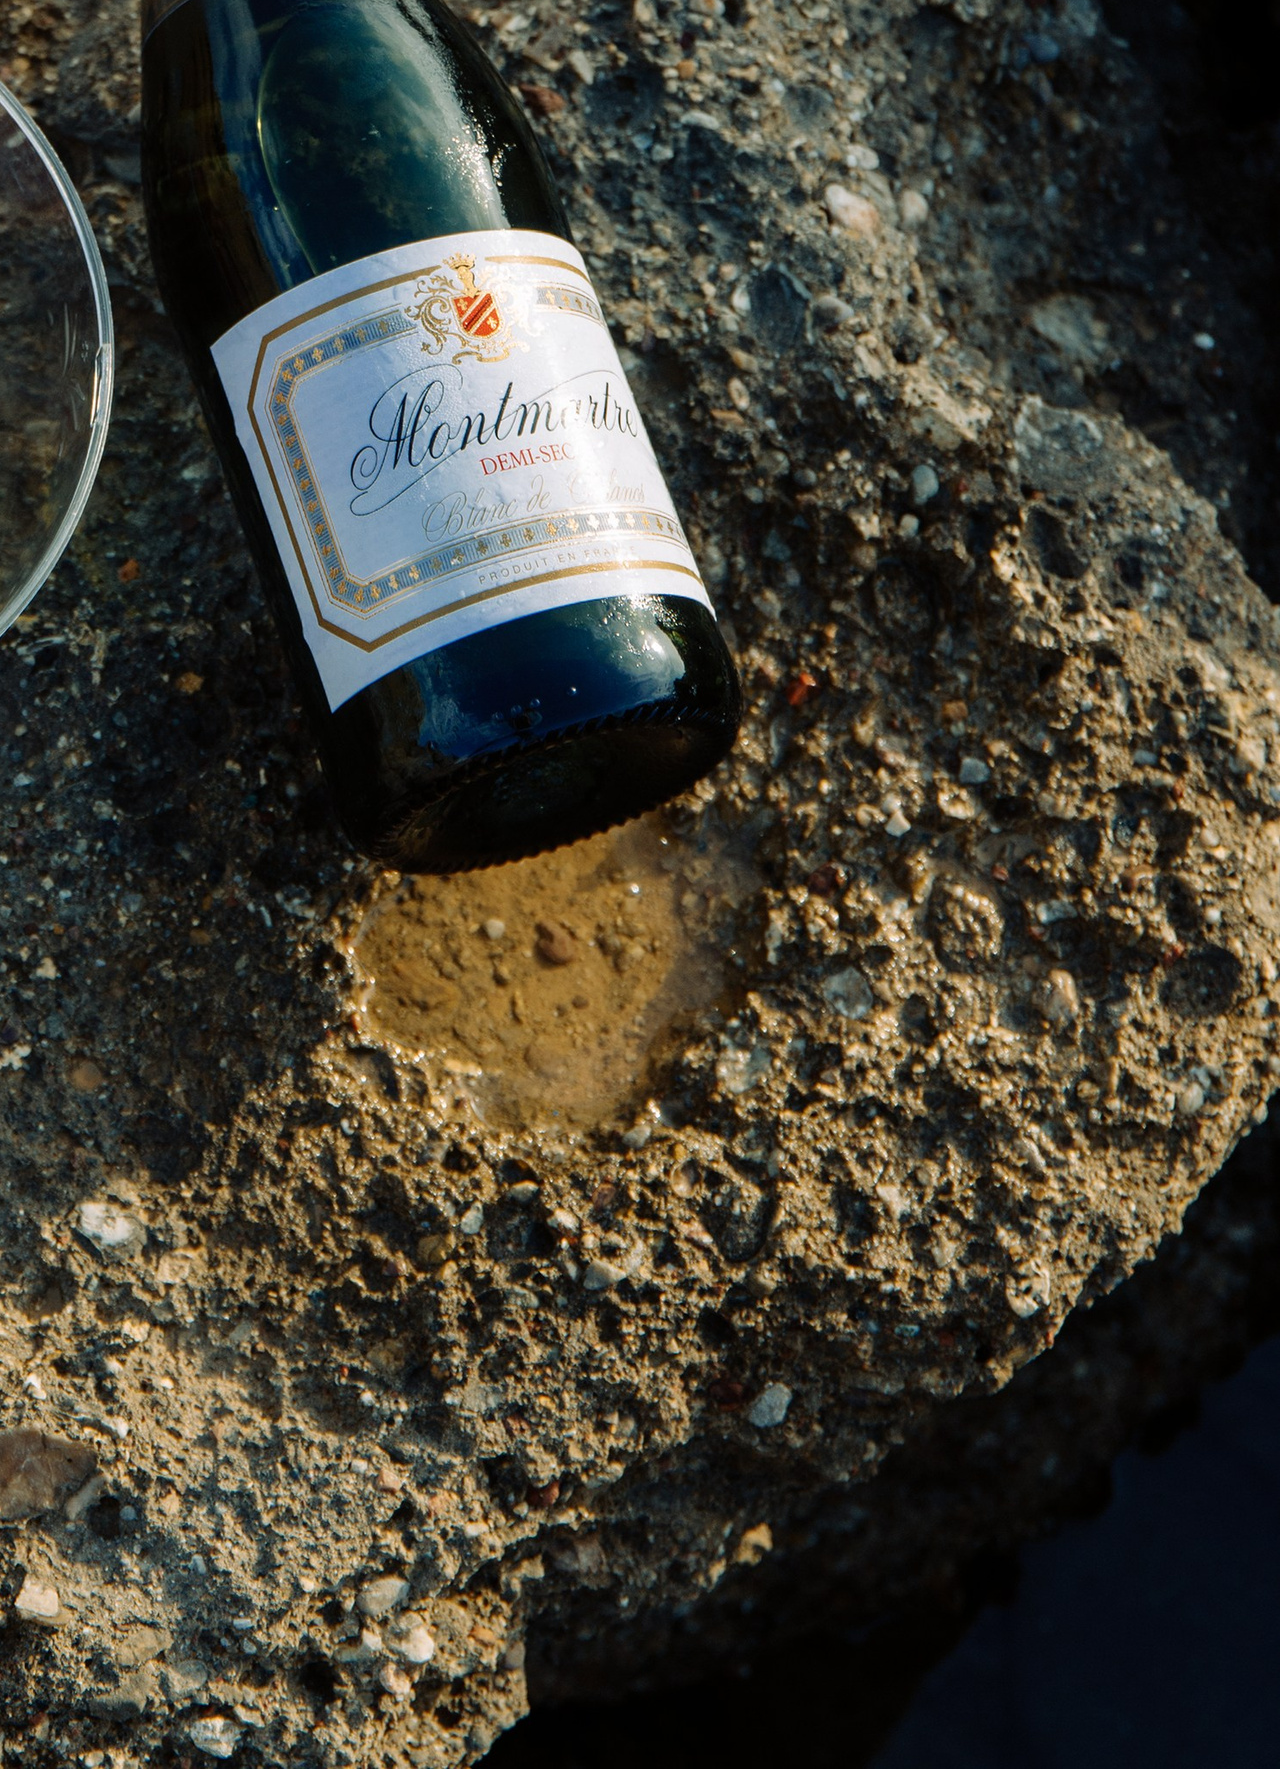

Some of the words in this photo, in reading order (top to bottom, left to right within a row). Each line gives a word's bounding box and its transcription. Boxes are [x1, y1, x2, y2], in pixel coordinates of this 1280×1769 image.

[479, 441, 576, 476] DEMI-SEC
[422, 486, 518, 543] Blanc
[526, 473, 552, 513] de
[478, 557, 549, 585] PRODUIT
[558, 552, 577, 564] EN
